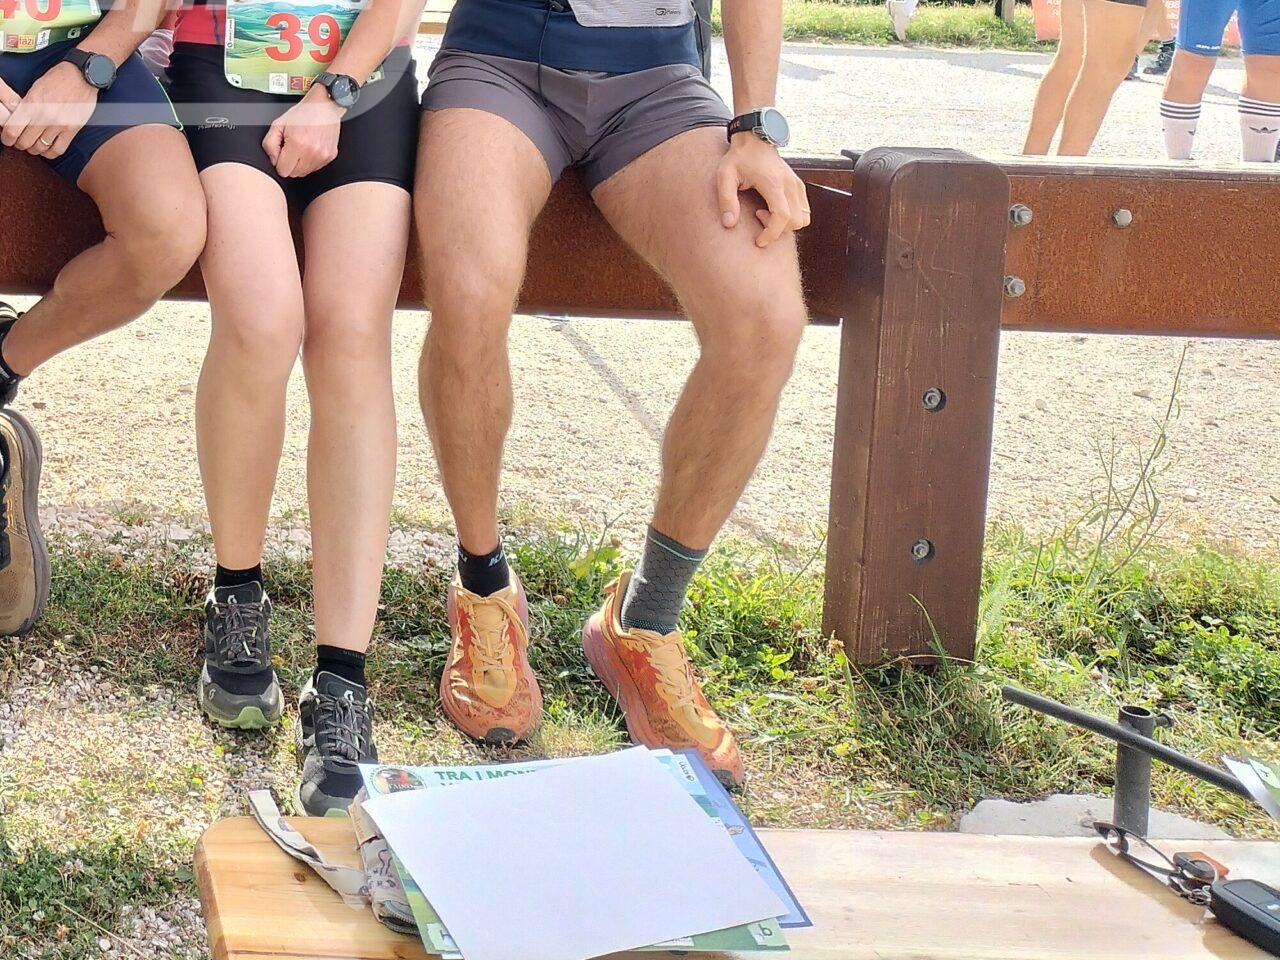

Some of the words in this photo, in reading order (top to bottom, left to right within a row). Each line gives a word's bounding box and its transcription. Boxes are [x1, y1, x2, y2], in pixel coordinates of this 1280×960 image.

[265, 13, 342, 63] 39
[435, 771, 473, 781] TRA
[476, 771, 483, 781] I
